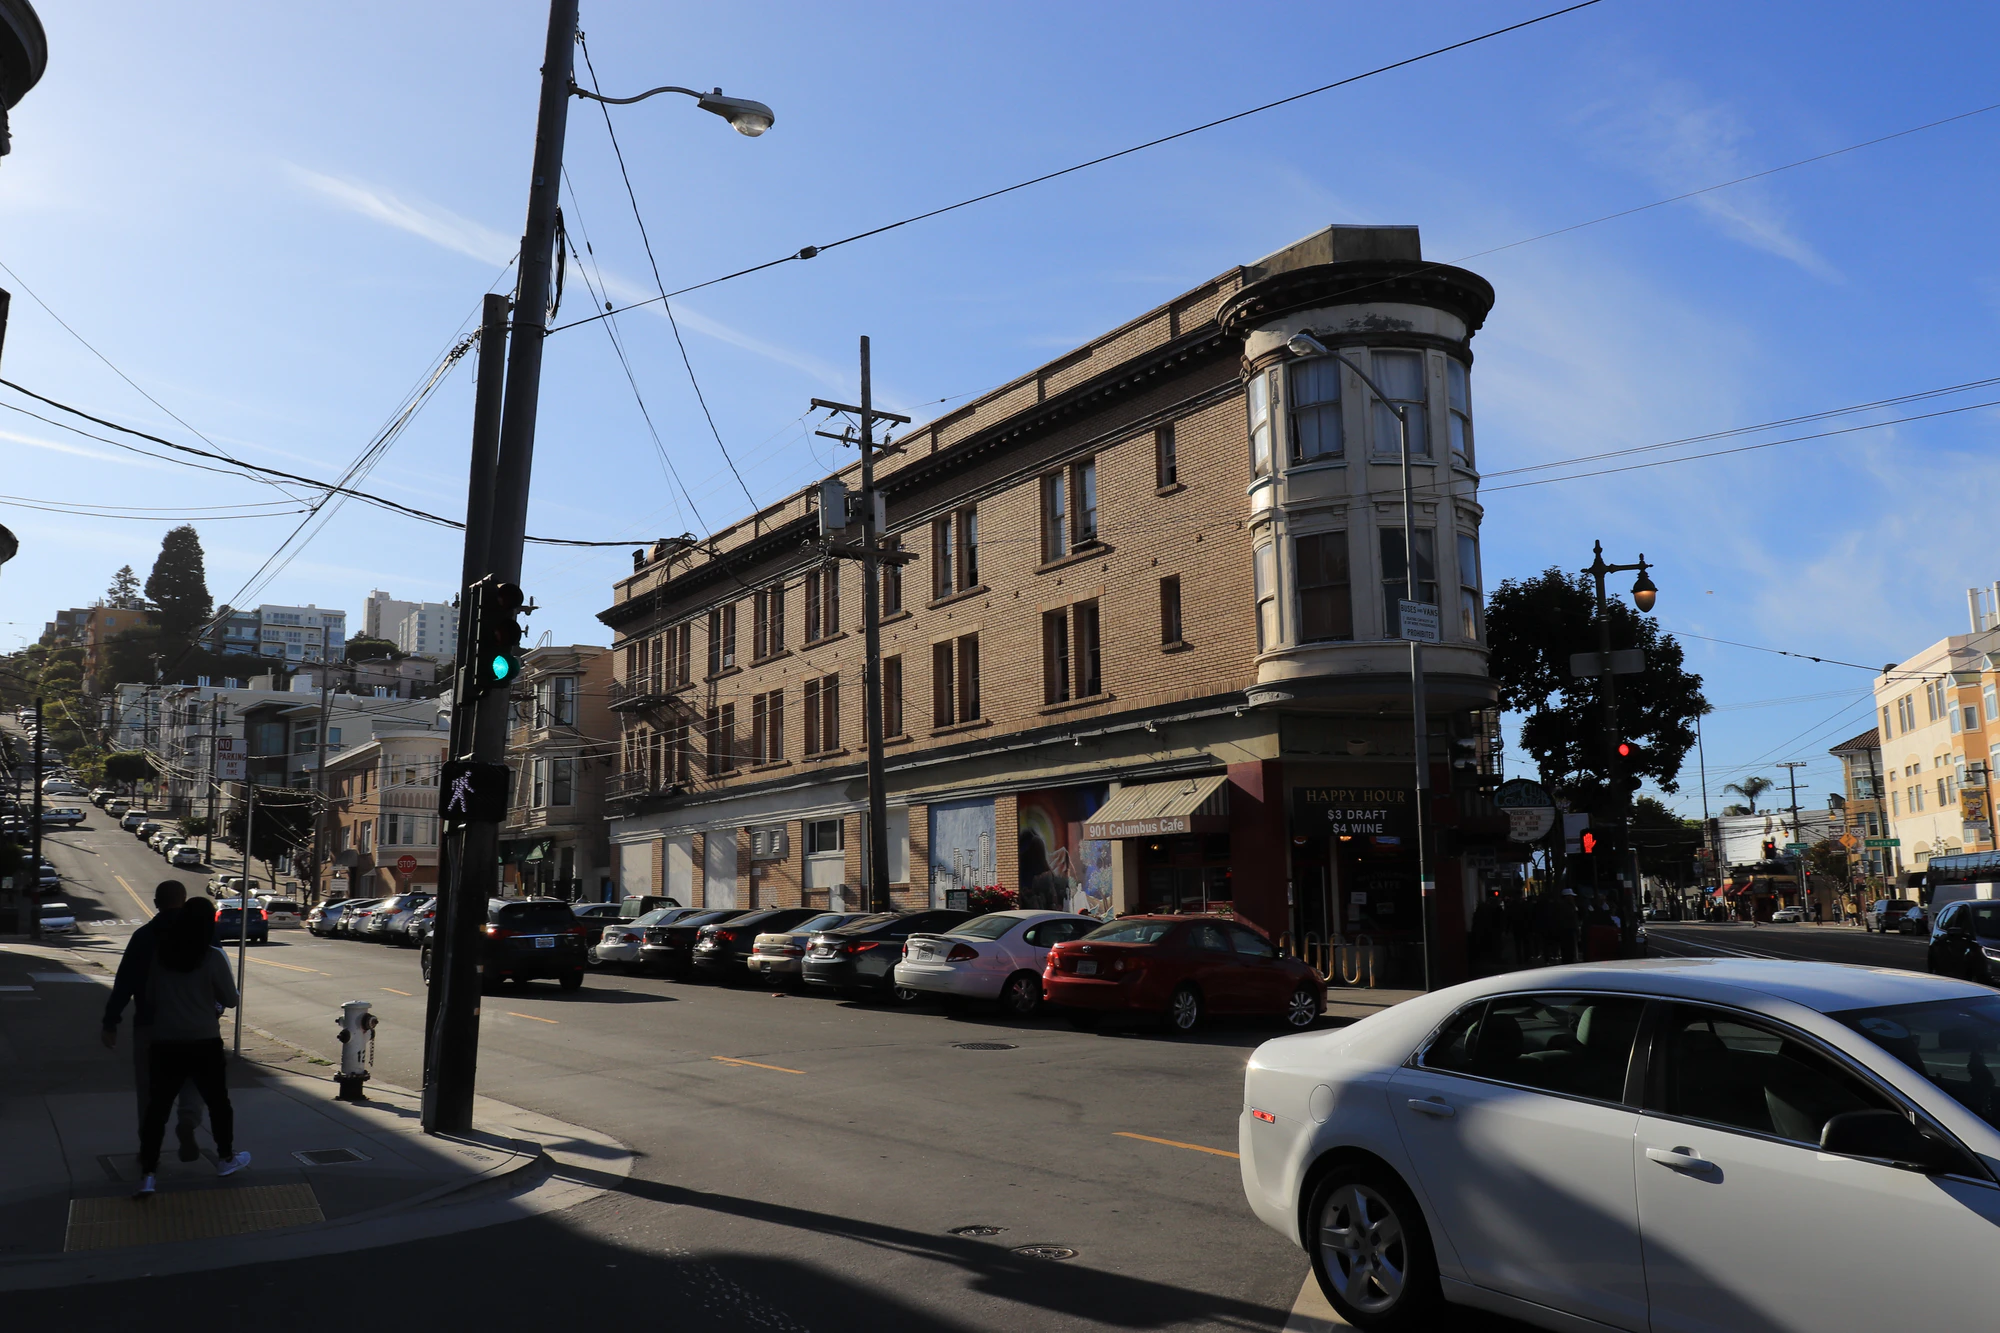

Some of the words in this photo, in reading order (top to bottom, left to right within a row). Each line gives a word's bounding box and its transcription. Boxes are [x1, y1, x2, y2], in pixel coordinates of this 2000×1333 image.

[1401, 604, 1416, 613] BUSES
[1423, 607, 1438, 617] VANS
[1407, 628, 1434, 639] PROHIBITED
[219, 739, 231, 750] NO
[219, 752, 246, 761] PARKING
[1306, 789, 1357, 802] HAPPY
[1363, 789, 1406, 803] HOUR
[1327, 809, 1342, 820] $3
[1347, 809, 1387, 820] DRAFT
[1089, 825, 1106, 838] 901
[1109, 821, 1157, 836] Columbus
[1160, 818, 1184, 832] Cafe
[1332, 822, 1347, 834] $4
[1351, 823, 1384, 834] WINE
[398, 860, 416, 868] STOP
[89, 919, 143, 927] STOP
